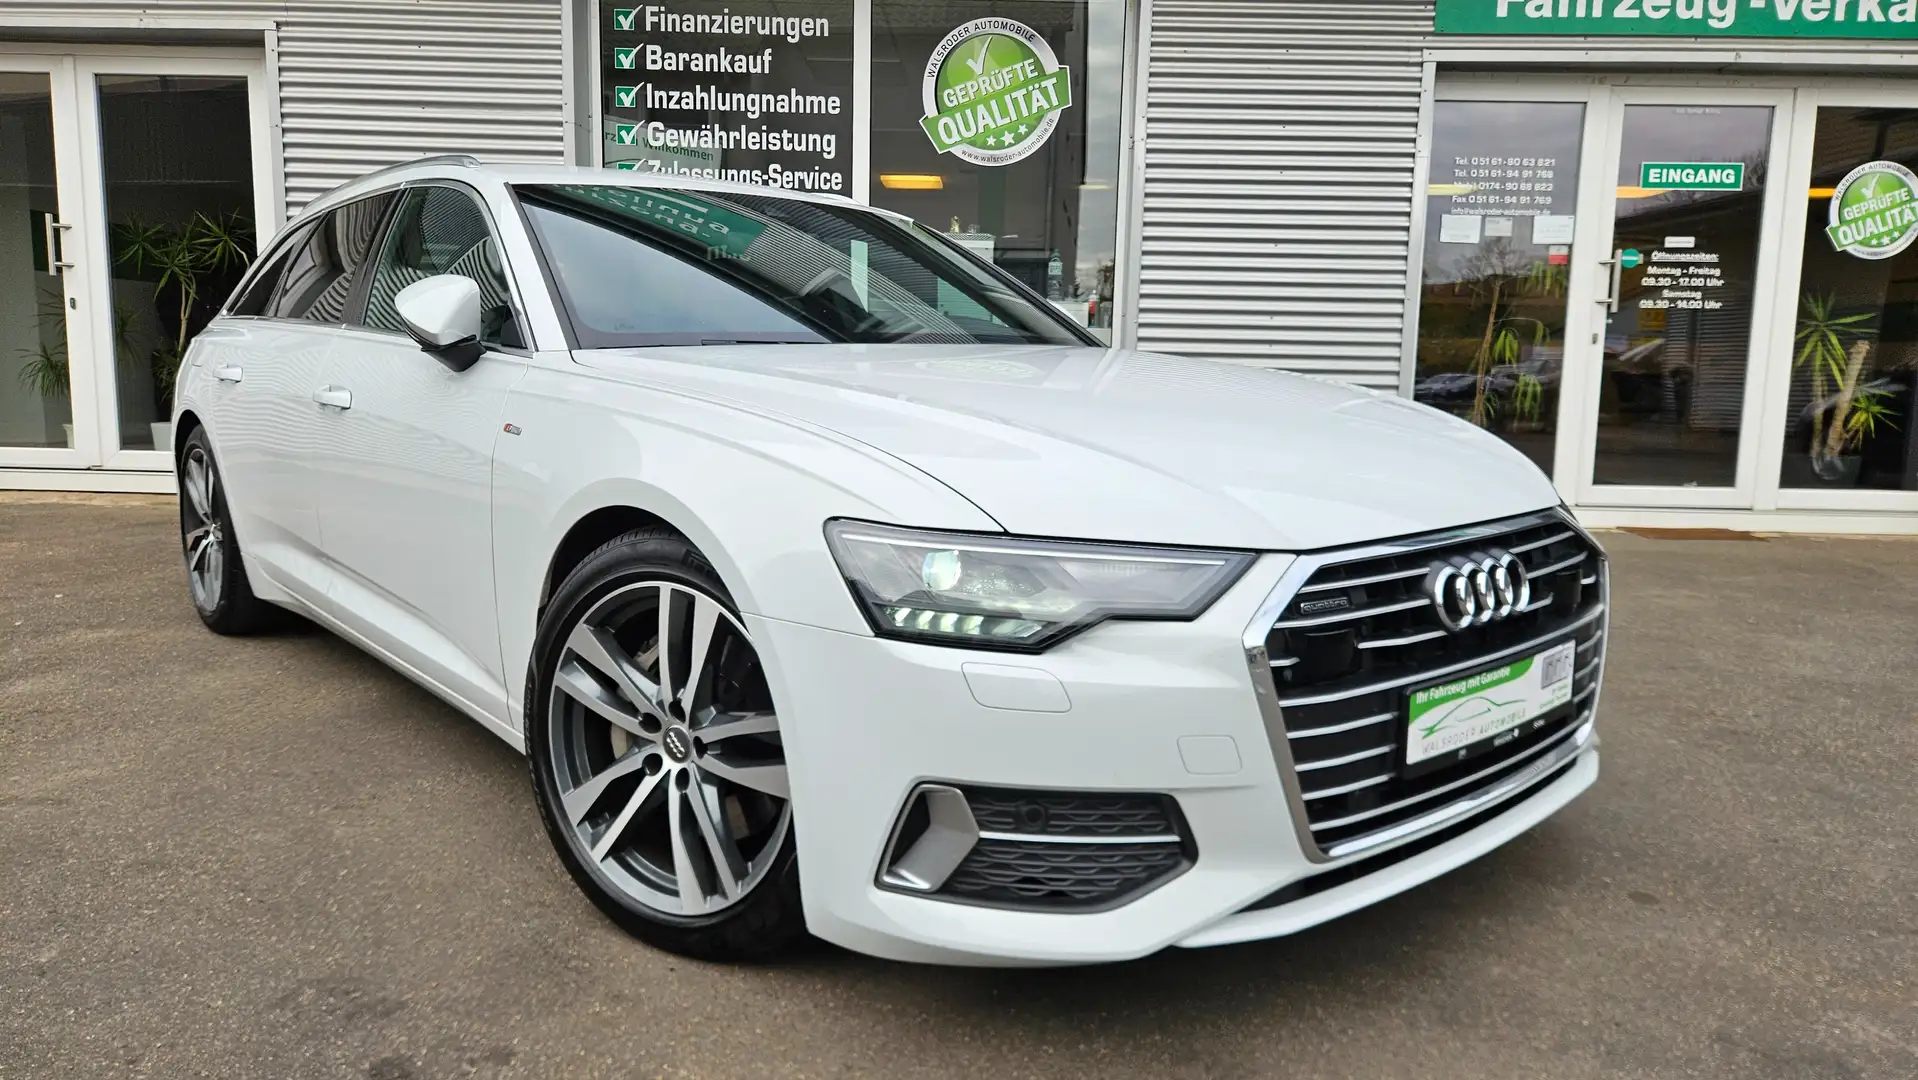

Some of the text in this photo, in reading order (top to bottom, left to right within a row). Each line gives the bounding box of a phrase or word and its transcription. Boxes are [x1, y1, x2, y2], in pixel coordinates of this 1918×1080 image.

[645, 5, 829, 43] Finanzierungen
[974, 20, 1036, 43] AUTOMOBILE
[645, 45, 772, 74] Barankauf
[927, 26, 970, 78] WALSRODER
[942, 58, 1039, 108] GEPRÜFTE
[646, 83, 841, 119] Inzahlungnahme
[937, 77, 1060, 145] QUALITÄT
[647, 121, 836, 160] Gewährleistung
[1648, 168, 1736, 184] EINGANG
[1452, 195, 1467, 203] Fax
[1843, 187, 1911, 220] GEPRÜFTE
[1641, 277, 1671, 286] 09.30
[1706, 278, 1725, 287] Uhr
[1646, 266, 1681, 276] Montag
[1688, 266, 1721, 277] Freitag
[1661, 289, 1702, 299] Samstag
[1704, 300, 1723, 309] Uhr
[1416, 689, 1428, 704] Ihr
[1429, 680, 1467, 701] Fahrzeug
[1467, 677, 1481, 688] mit
